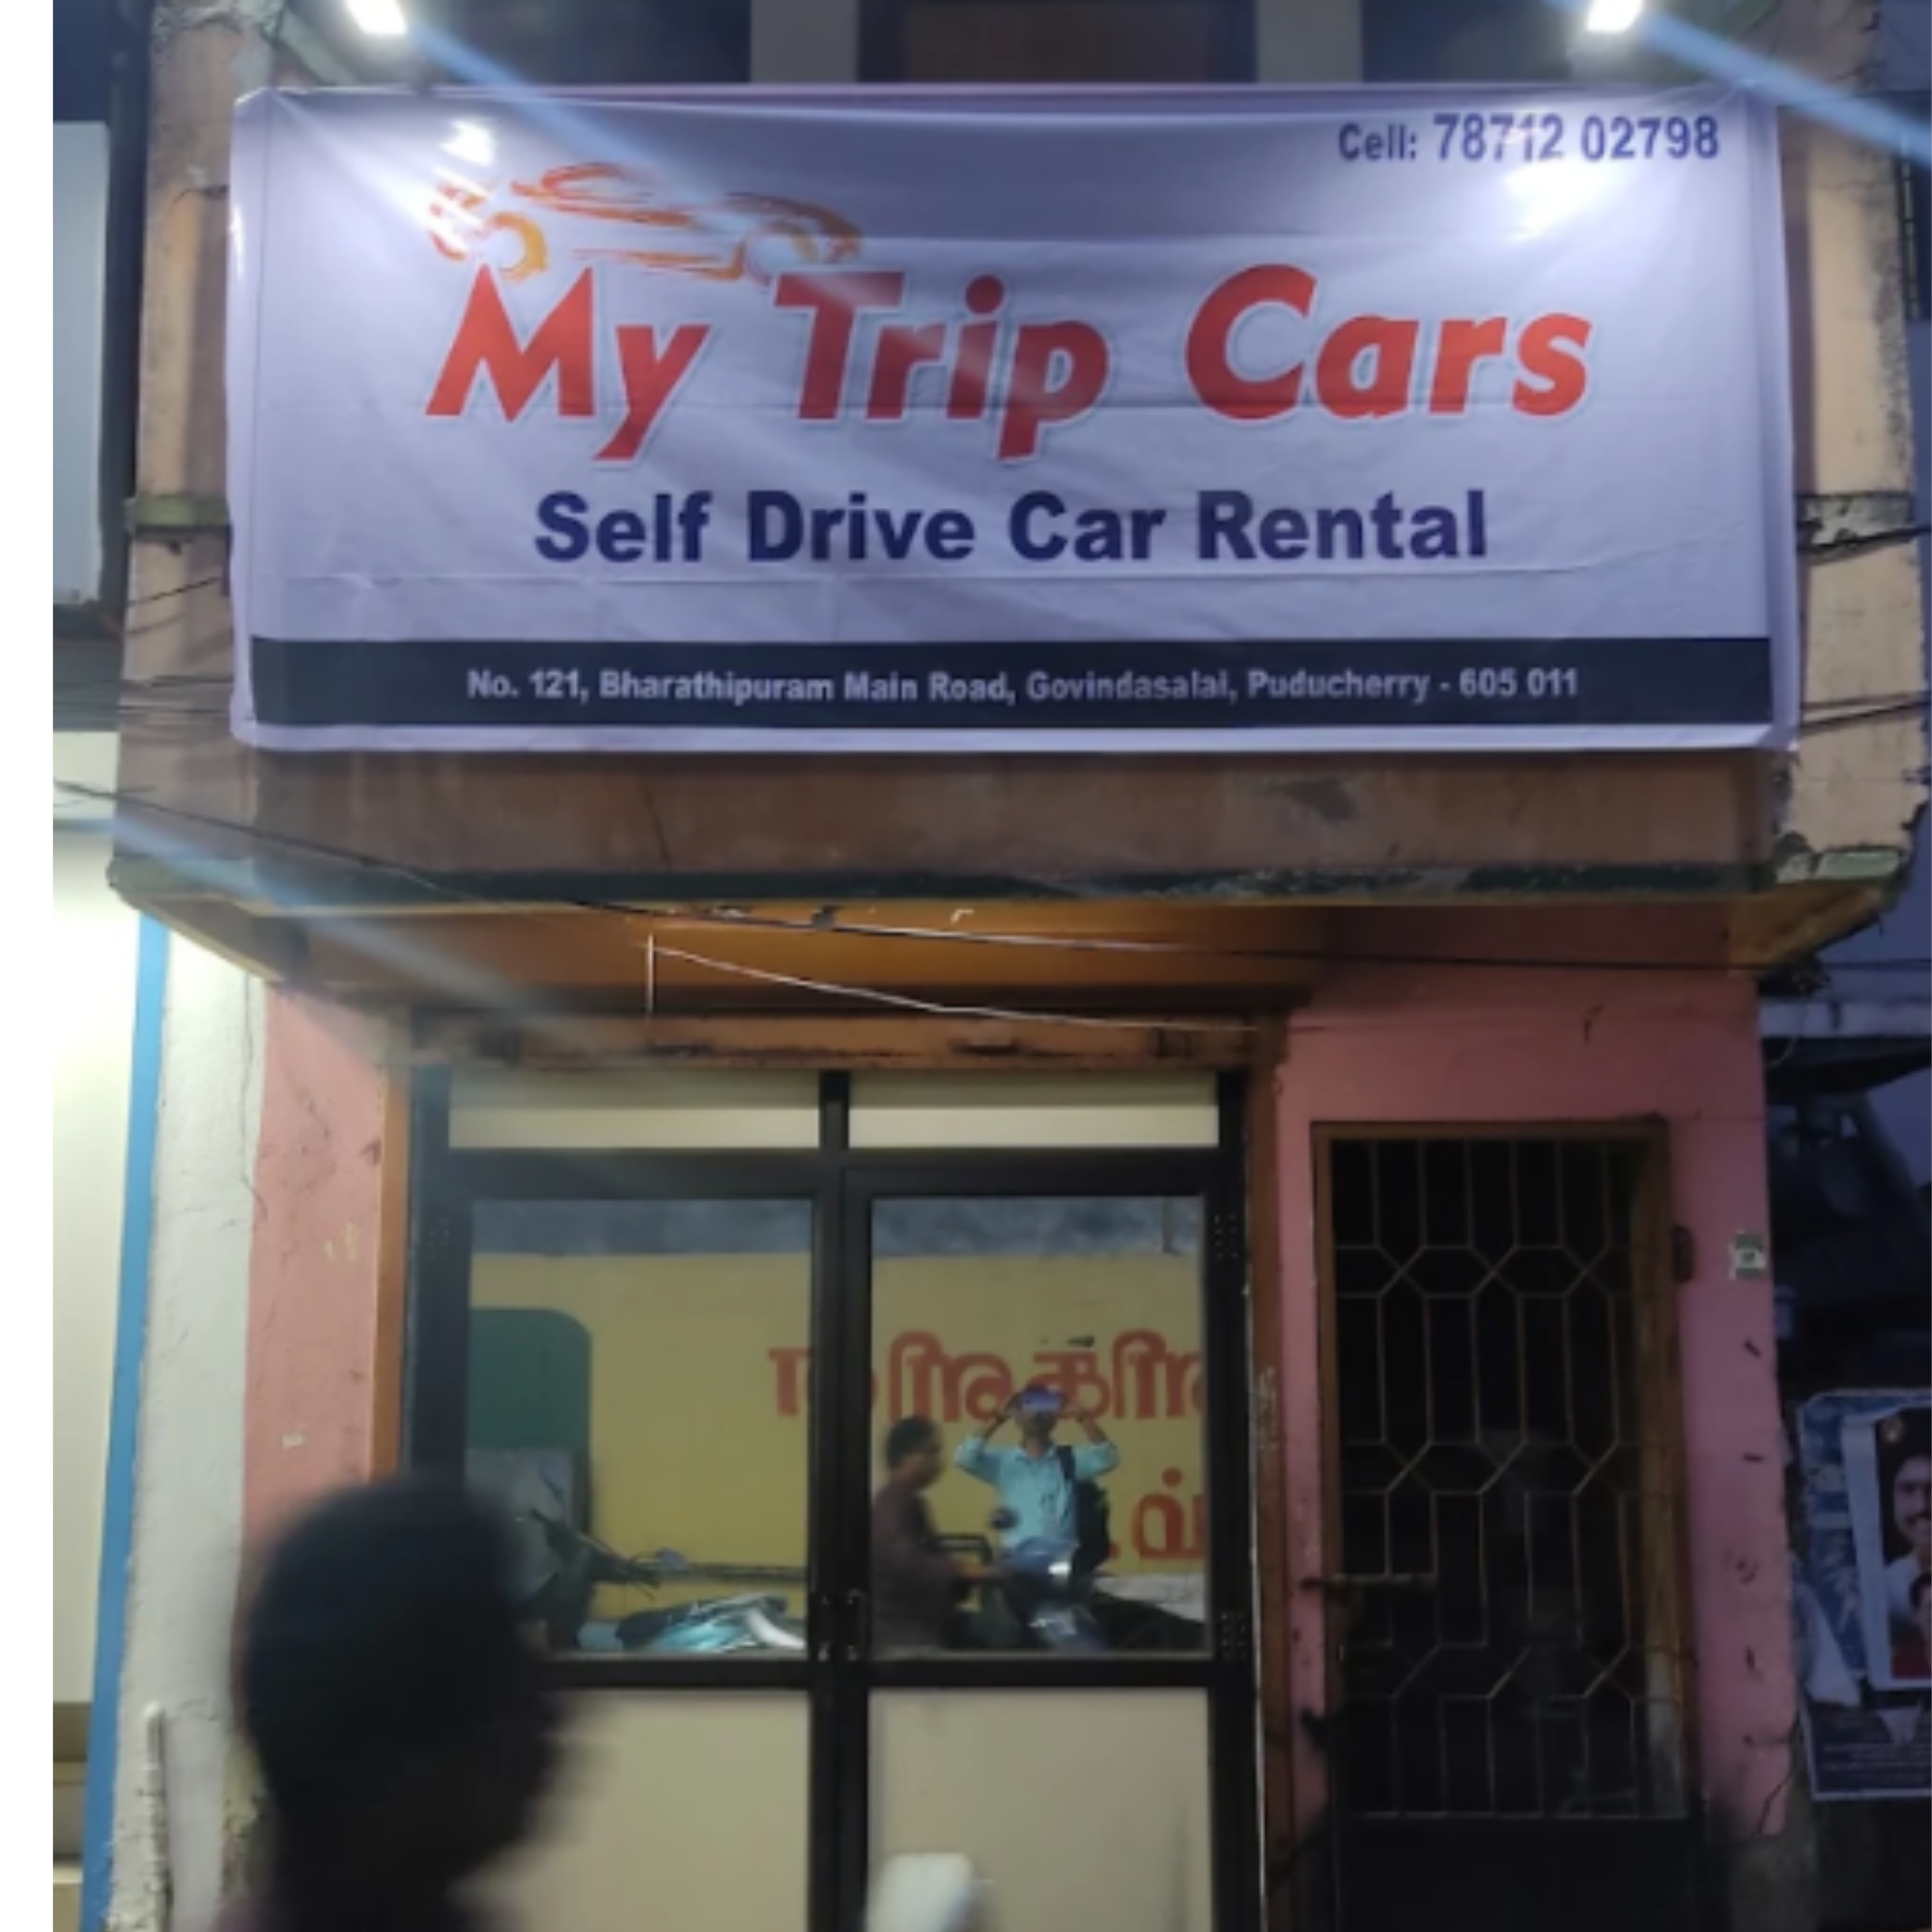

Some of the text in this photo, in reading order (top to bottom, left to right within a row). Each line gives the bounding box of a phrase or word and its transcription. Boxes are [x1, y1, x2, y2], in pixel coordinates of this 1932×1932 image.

[1338, 112, 1719, 162] Cell: 78712 02798
[425, 263, 1593, 462] My Trip Cars
[535, 489, 1487, 562] Self Drive Car Rental
[467, 668, 520, 698] No.
[529, 668, 589, 703] 121,
[599, 668, 835, 706] Bharathipuram
[843, 671, 919, 700] Main
[928, 670, 1016, 705] Road,
[1026, 669, 1237, 703] Govindasalai,
[1247, 668, 1432, 703] Puducherry
[1459, 667, 1518, 697] 605
[1526, 667, 1578, 697] 011
